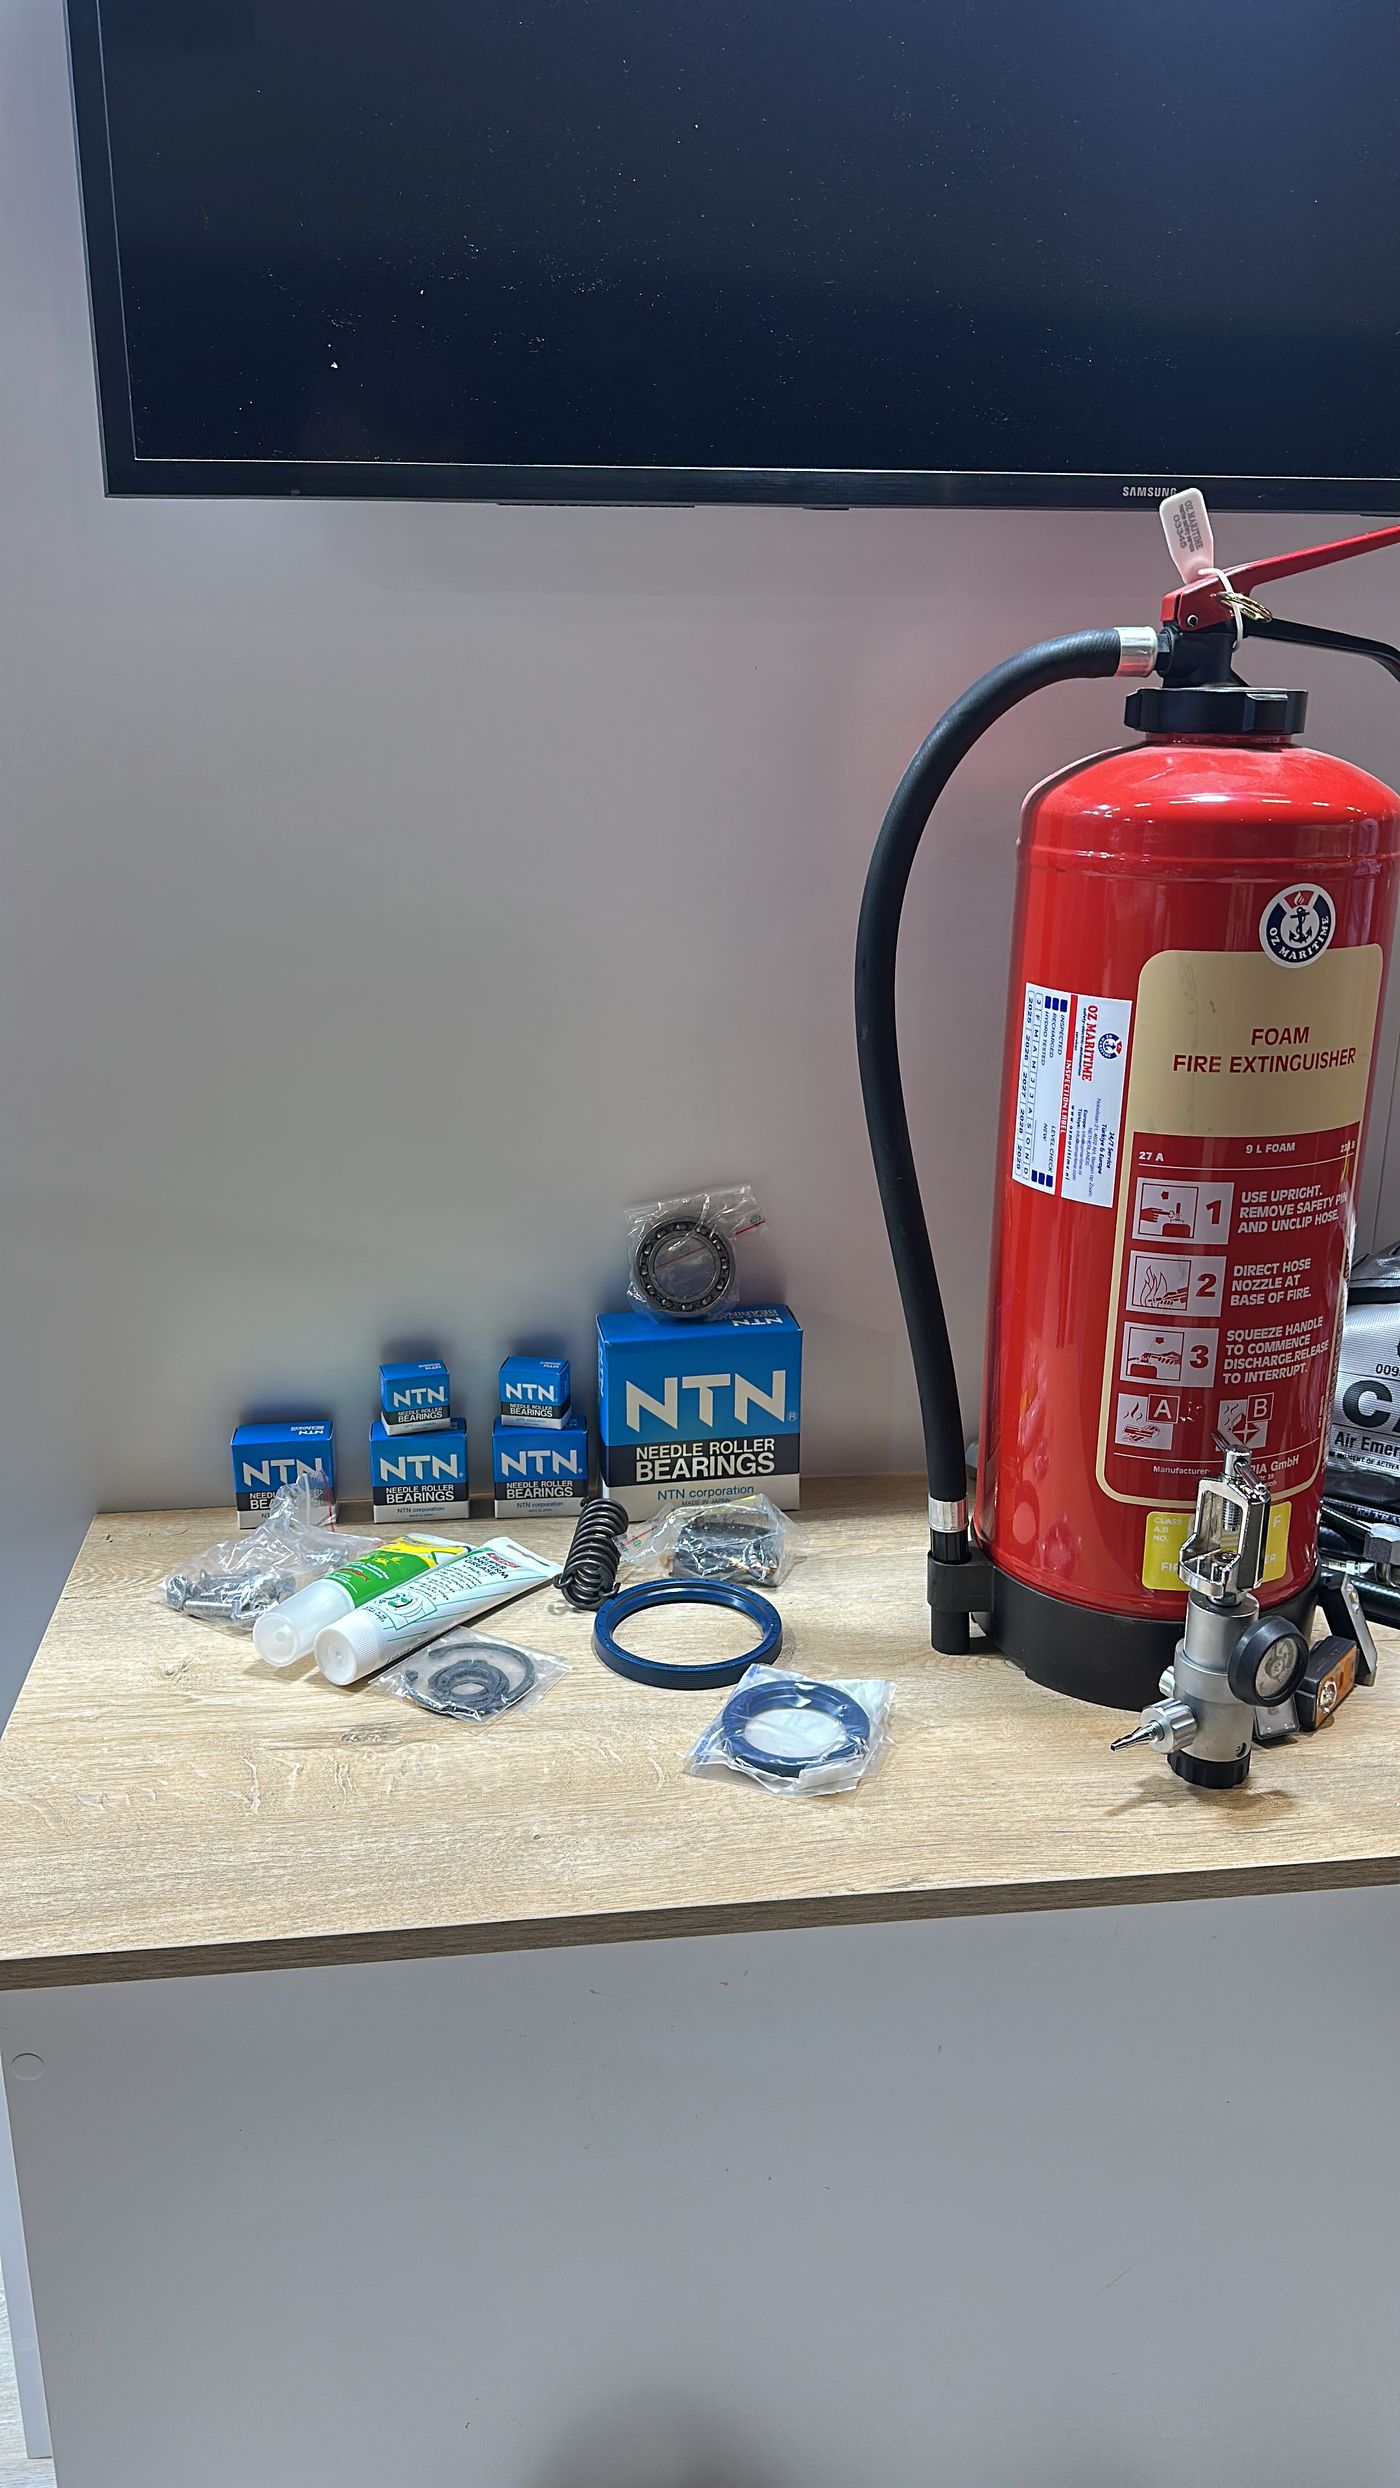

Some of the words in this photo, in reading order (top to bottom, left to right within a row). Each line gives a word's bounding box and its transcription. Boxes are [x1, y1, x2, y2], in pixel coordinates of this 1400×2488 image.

[1122, 486, 1177, 497] SAMSUNG
[1269, 927, 1280, 946] OZ
[1279, 916, 1329, 960] MARITIME
[1087, 1005, 1098, 1020] OZ
[1049, 1013, 1057, 1058] RECHARGED
[1251, 1026, 1310, 1046] FOAM
[1082, 1024, 1096, 1081] MARITIME
[1173, 1054, 1222, 1073] FIRE
[1229, 1047, 1356, 1073] EXTINGUISHER
[1061, 1059, 1071, 1108] INSPECTION
[1138, 1151, 1152, 1161] 27
[1155, 1153, 1164, 1162] A
[1245, 1144, 1253, 1154] 9
[1256, 1144, 1263, 1153] L
[1265, 1142, 1296, 1153] FOAM
[1241, 1191, 1267, 1204] USE
[1271, 1185, 1323, 1202] UPRIGHT.
[1205, 1200, 1222, 1225] 1
[1239, 1204, 1294, 1219] REMOVE
[1296, 1197, 1335, 1213] SAFETY
[1335, 1191, 1348, 1206] PIN
[1237, 1221, 1268, 1234] AND
[1271, 1216, 1313, 1232] UNCLIP
[1233, 1263, 1278, 1277] DIRECT
[1282, 1258, 1312, 1272] HOSE
[1195, 1273, 1217, 1298] 2
[1231, 1278, 1282, 1292] NOZZLE
[1284, 1274, 1301, 1287] AT
[1230, 1294, 1265, 1306] BASE
[1267, 1291, 1285, 1304] OF
[1286, 1287, 1312, 1300] FIRE.
[733, 1317, 784, 1328] NTN
[1226, 1326, 1283, 1343] SQUEEZE
[1285, 1316, 1324, 1335] HANDLE
[1226, 1344, 1245, 1356] TO
[1247, 1334, 1311, 1355] COMMENCE
[1189, 1345, 1209, 1369] 3
[1223, 1373, 1242, 1385] TO
[1244, 1363, 1308, 1383] INTERRUPT.
[393, 1386, 445, 1408] NTN
[506, 1383, 554, 1402] NTN
[626, 1370, 787, 1433] NTN
[398, 1411, 443, 1423] BEARINGS
[420, 1406, 443, 1414] ROLLER
[510, 1407, 553, 1418] BEARINGS
[1153, 1399, 1172, 1419] A
[1253, 1399, 1268, 1418] B
[636, 1443, 703, 1460] NEEDLE
[709, 1438, 775, 1454] ROLLER
[1334, 1431, 1357, 1448] Air
[243, 1458, 323, 1487] NTN
[380, 1454, 458, 1482] NTN
[501, 1450, 577, 1477] NTN
[636, 1453, 775, 1482] BEARINGS
[1250, 1463, 1267, 1475] RIA
[1270, 1454, 1300, 1472] GmbH
[386, 1486, 419, 1494] NEEDLE
[421, 1484, 454, 1492] ROLLER
[506, 1481, 538, 1489] NEEDLE
[506, 1487, 573, 1499] BEARINGS
[657, 1489, 685, 1501] NTN
[689, 1485, 754, 1499] corporation
[386, 1491, 455, 1504] BEARINGS
